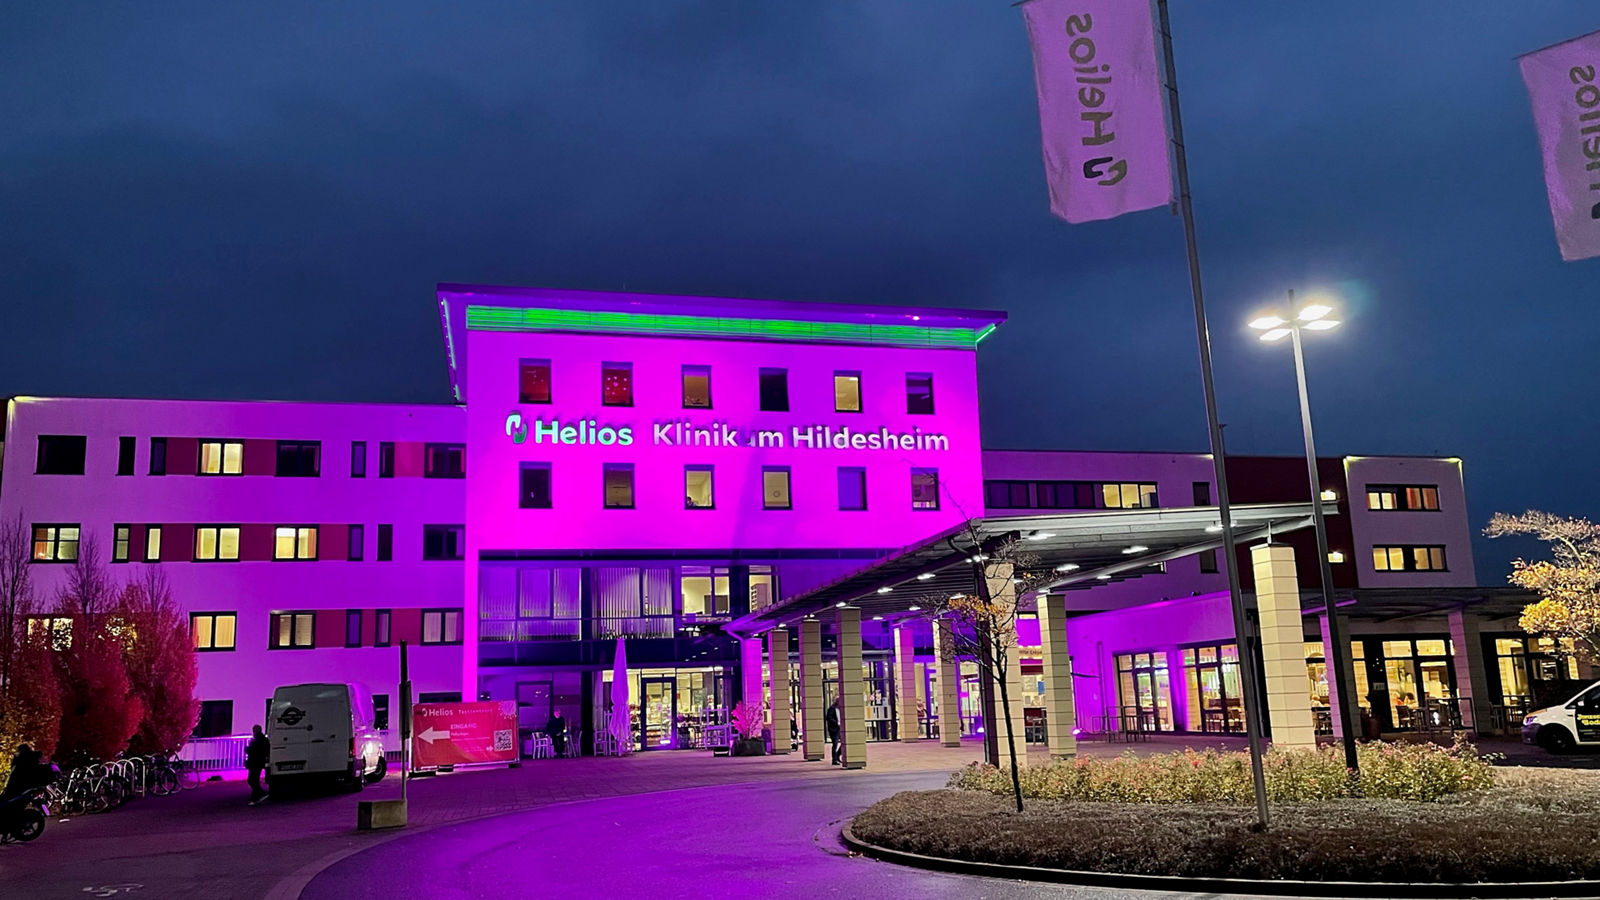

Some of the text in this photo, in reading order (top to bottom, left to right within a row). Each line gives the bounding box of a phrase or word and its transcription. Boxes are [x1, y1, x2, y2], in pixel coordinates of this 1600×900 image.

[535, 419, 634, 446] Helios
[792, 426, 950, 451] Hildesheim
[428, 708, 454, 717] Helios
